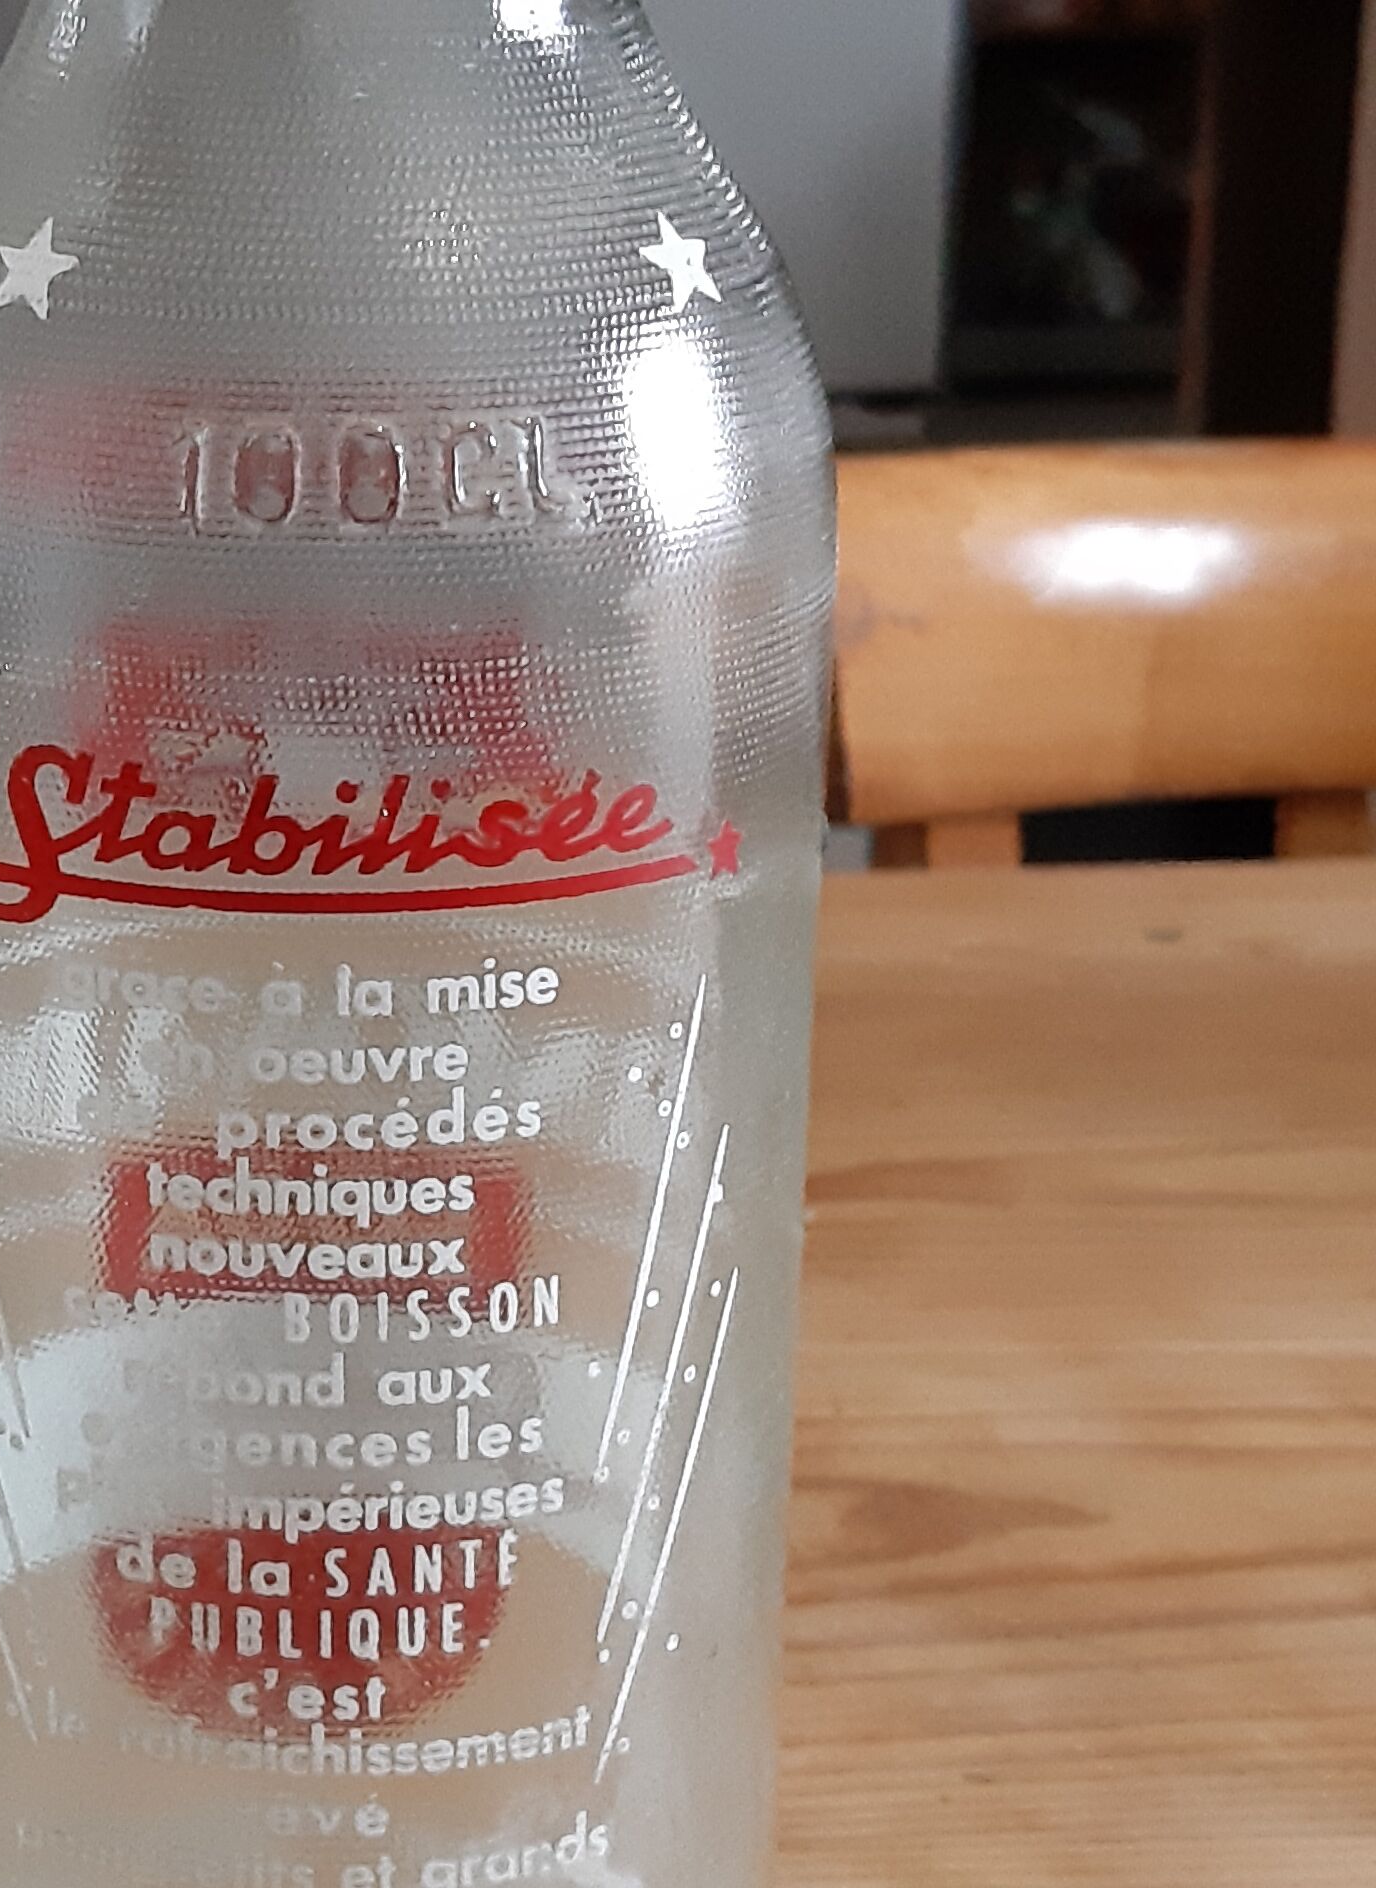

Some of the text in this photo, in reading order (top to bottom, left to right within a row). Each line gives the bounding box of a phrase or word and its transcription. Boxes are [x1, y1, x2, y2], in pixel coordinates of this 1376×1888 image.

[337, 962, 394, 1017] la
[426, 957, 560, 1014] mise
[251, 1040, 471, 1085] oeuvre
[216, 1085, 542, 1160] procédés
[146, 1156, 476, 1229] techniques
[148, 1232, 466, 1279] nouveaux
[282, 1274, 561, 1344] BOISSON
[376, 1360, 493, 1405] aux
[455, 1404, 545, 1462] les
[210, 1475, 566, 1546] impérieuses
[115, 1526, 519, 1599] de la SANTÉ
[227, 1666, 389, 1723] c'est
